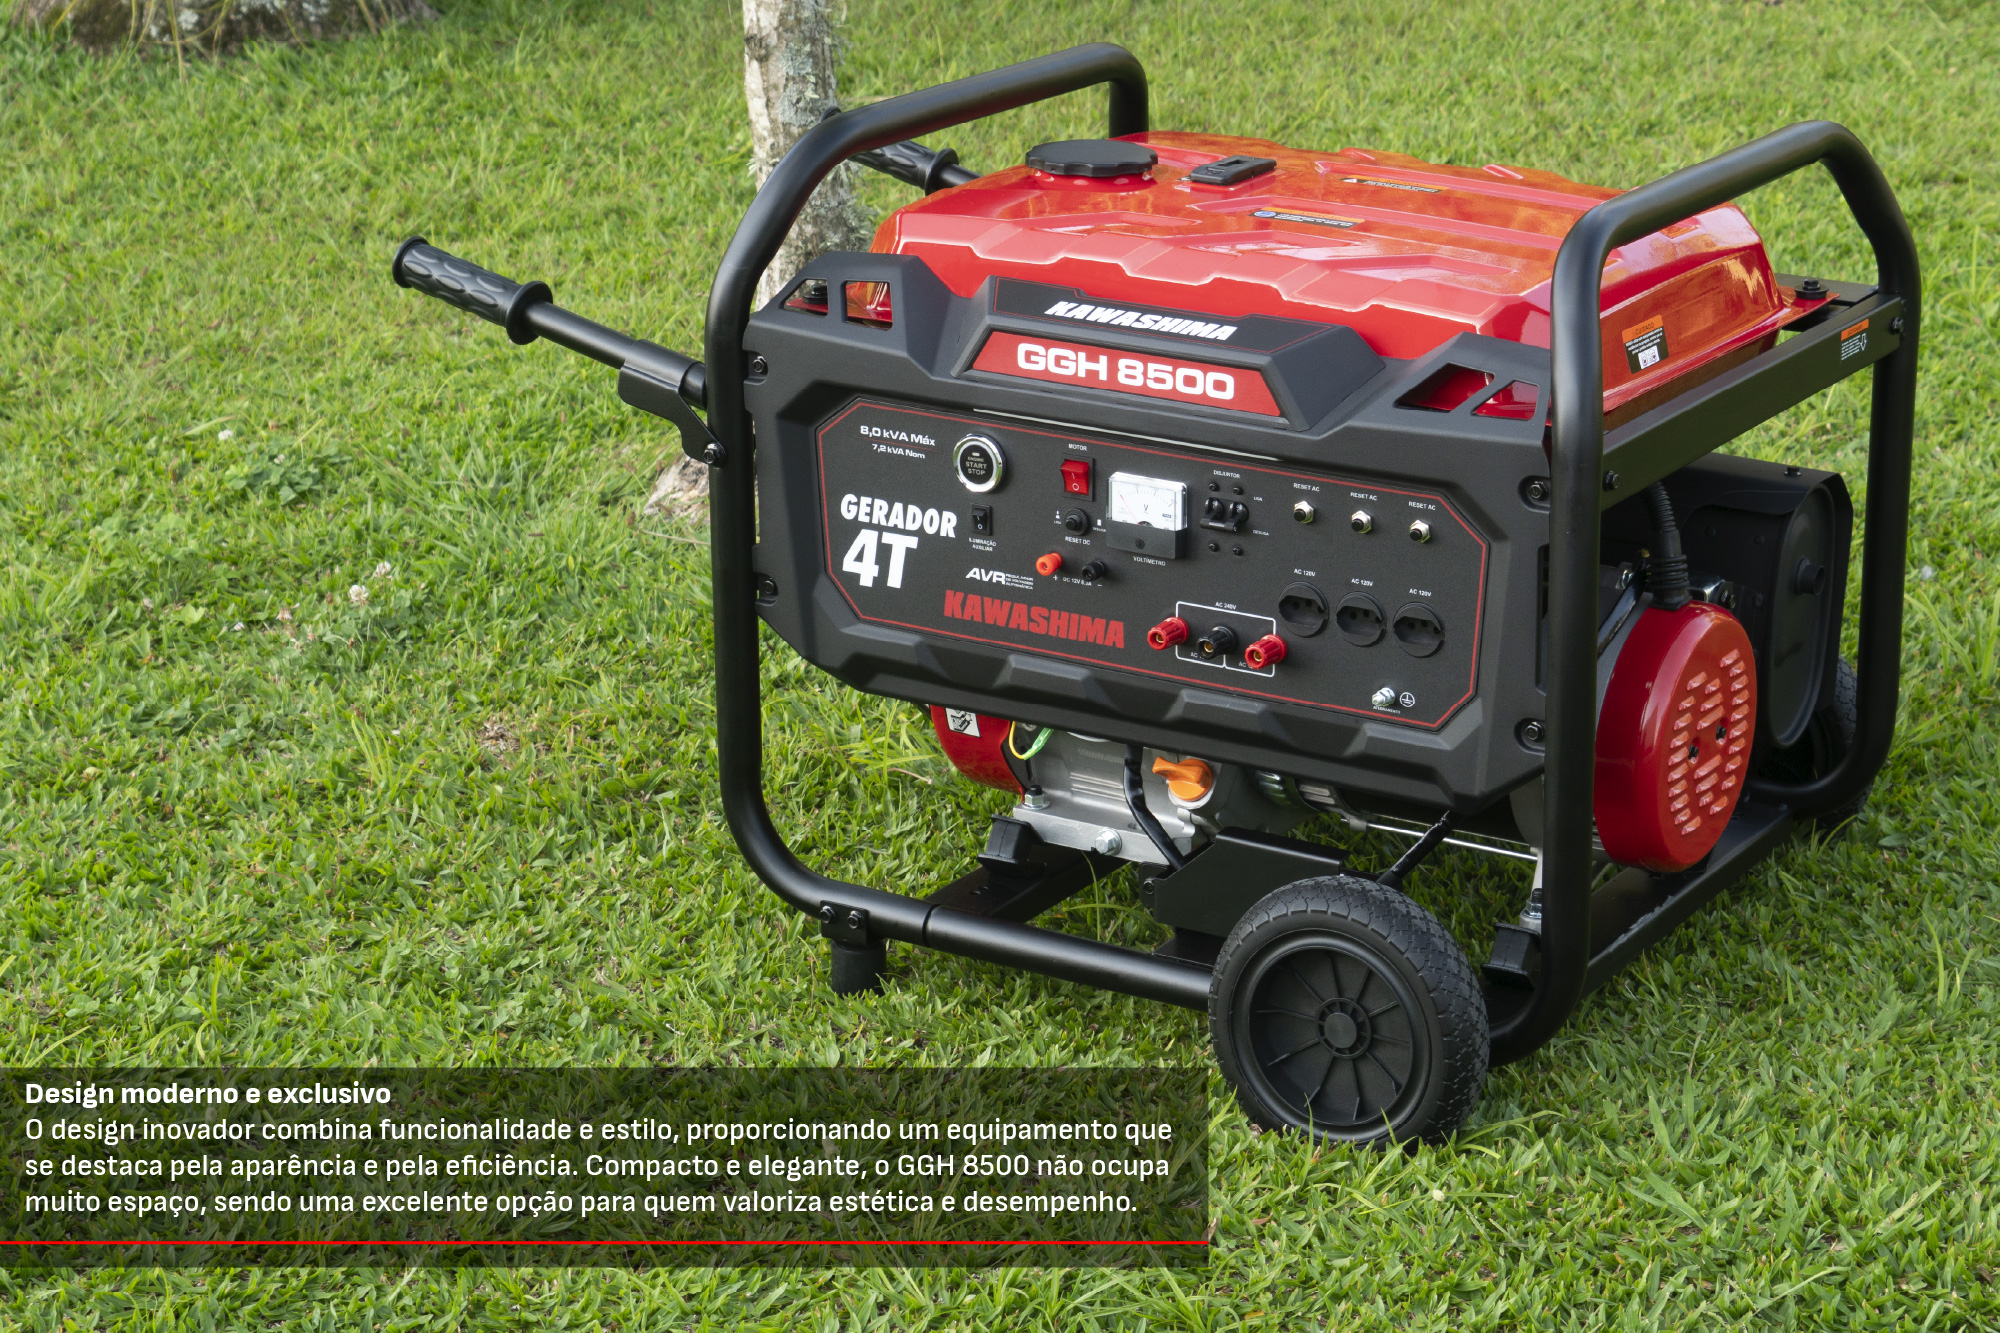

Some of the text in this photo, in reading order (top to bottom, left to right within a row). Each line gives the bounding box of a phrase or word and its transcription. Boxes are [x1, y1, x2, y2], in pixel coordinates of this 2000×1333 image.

[1044, 301, 1238, 341] KAWASHIMA
[1017, 343, 1235, 400] GGH 8500
[860, 425, 936, 446] 8,0 kVA Máx
[872, 443, 926, 459] 7,2 kVA Nom
[1068, 443, 1088, 451] MOTOR
[965, 461, 988, 470] START
[1213, 469, 1241, 479] DISJUNTOR
[1293, 482, 1309, 490] RESET
[1350, 491, 1367, 500] RESET
[1408, 501, 1427, 509] RESET
[840, 493, 957, 538] GERADOR
[1065, 536, 1091, 546] RESET DC
[842, 528, 919, 589] 4T
[965, 567, 1006, 585] AVR
[1071, 577, 1081, 585] 12V
[943, 589, 1125, 649] KAWASHIMA
